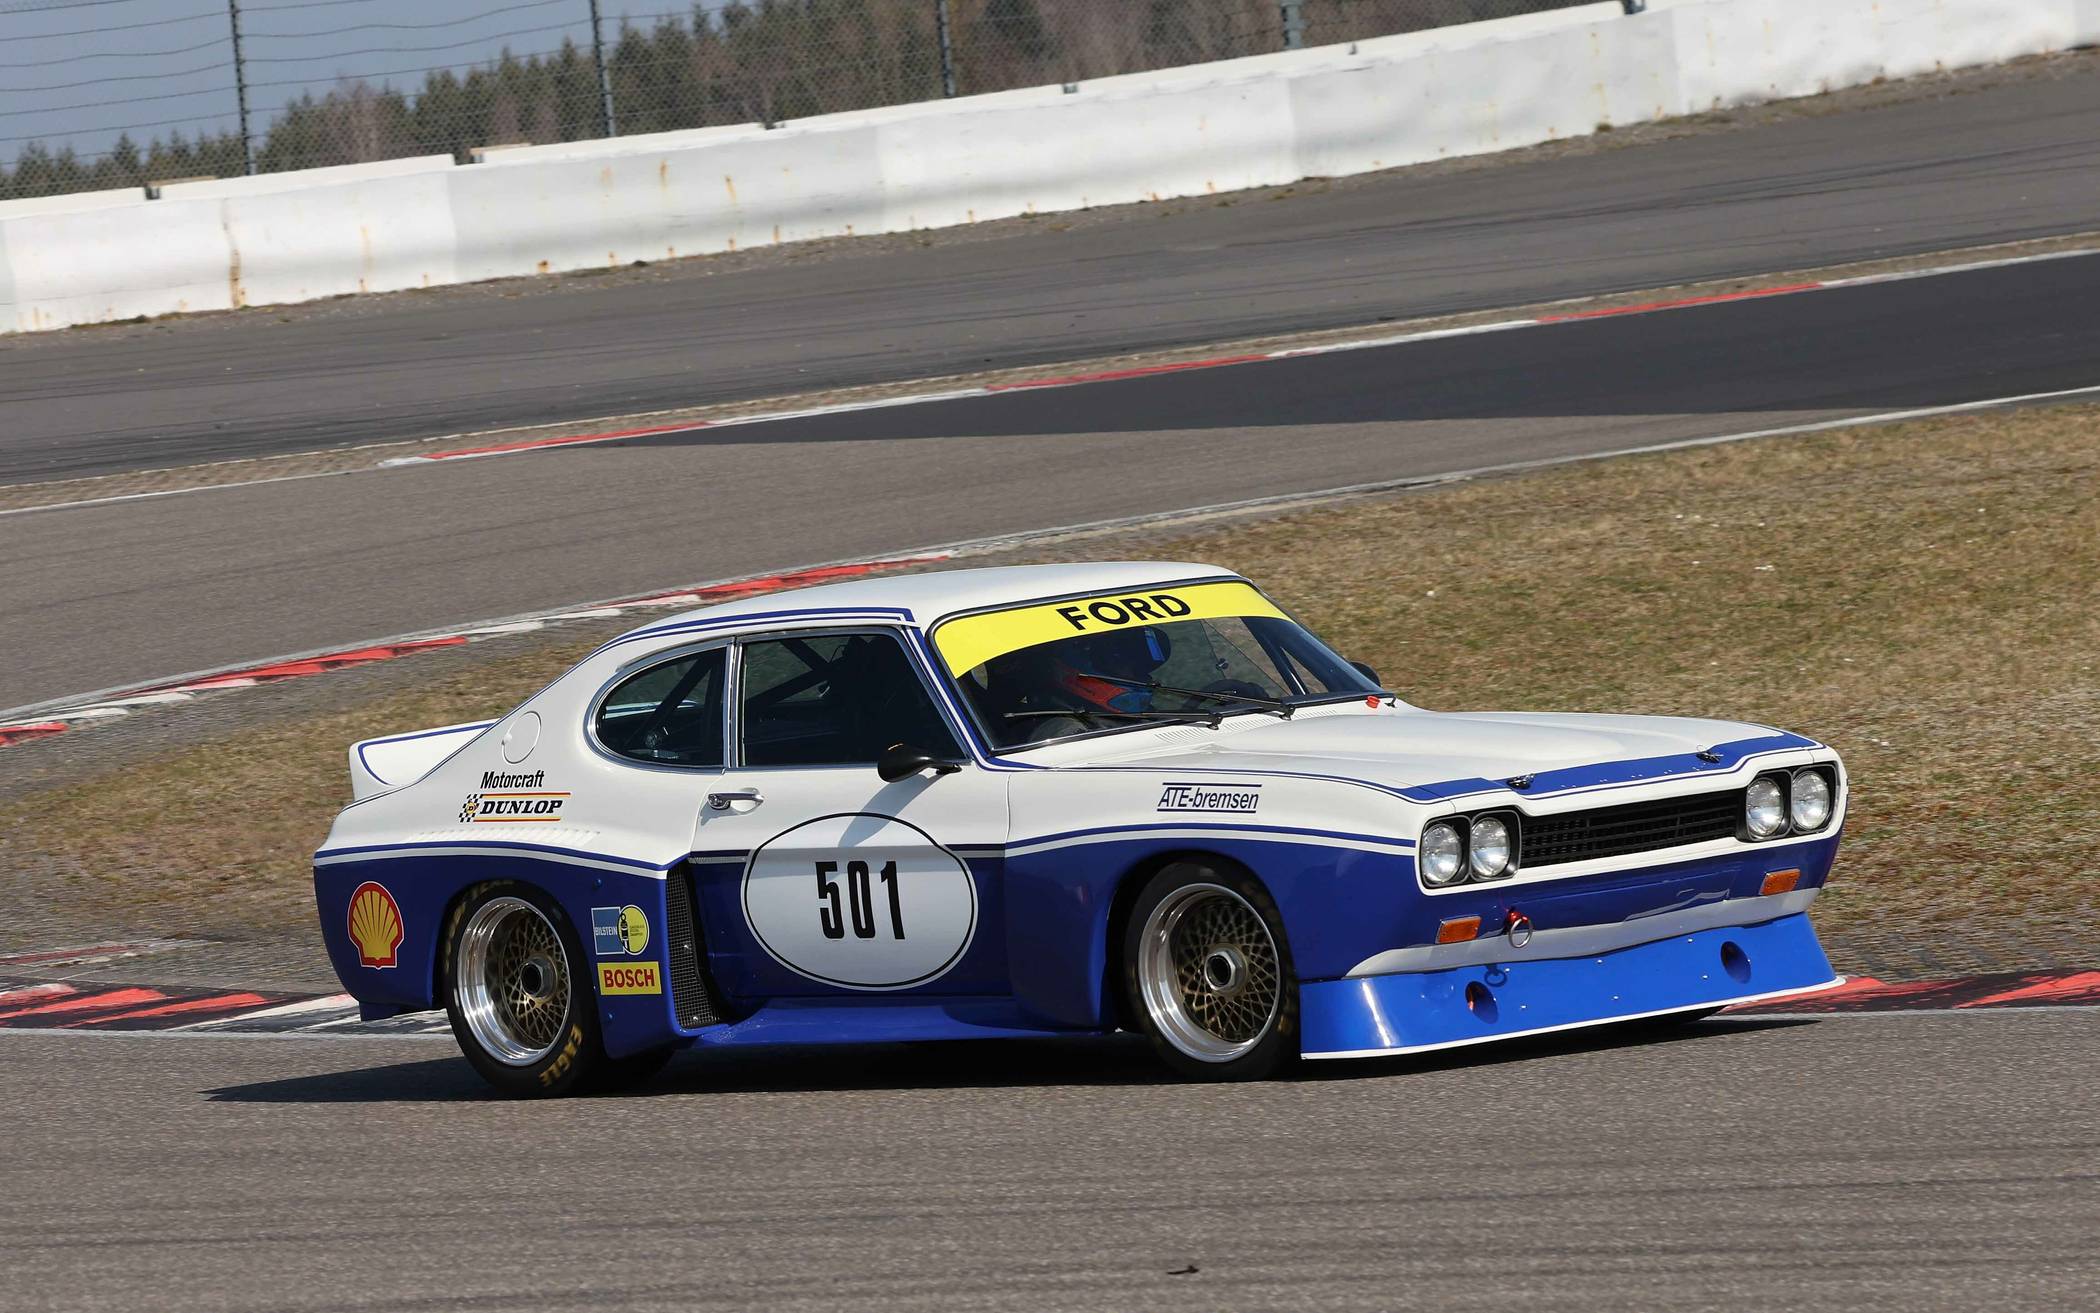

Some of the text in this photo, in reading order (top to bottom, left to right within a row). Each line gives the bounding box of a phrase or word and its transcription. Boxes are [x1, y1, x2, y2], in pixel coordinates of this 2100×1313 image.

[1055, 594, 1192, 631] FORD
[480, 769, 545, 790] Motorcraft
[480, 799, 563, 815] DUNLOP
[1157, 786, 1259, 809] ATE-bremsen
[815, 860, 905, 940] 501
[594, 925, 619, 936] BILSTEIN
[603, 968, 655, 988] BOSCH
